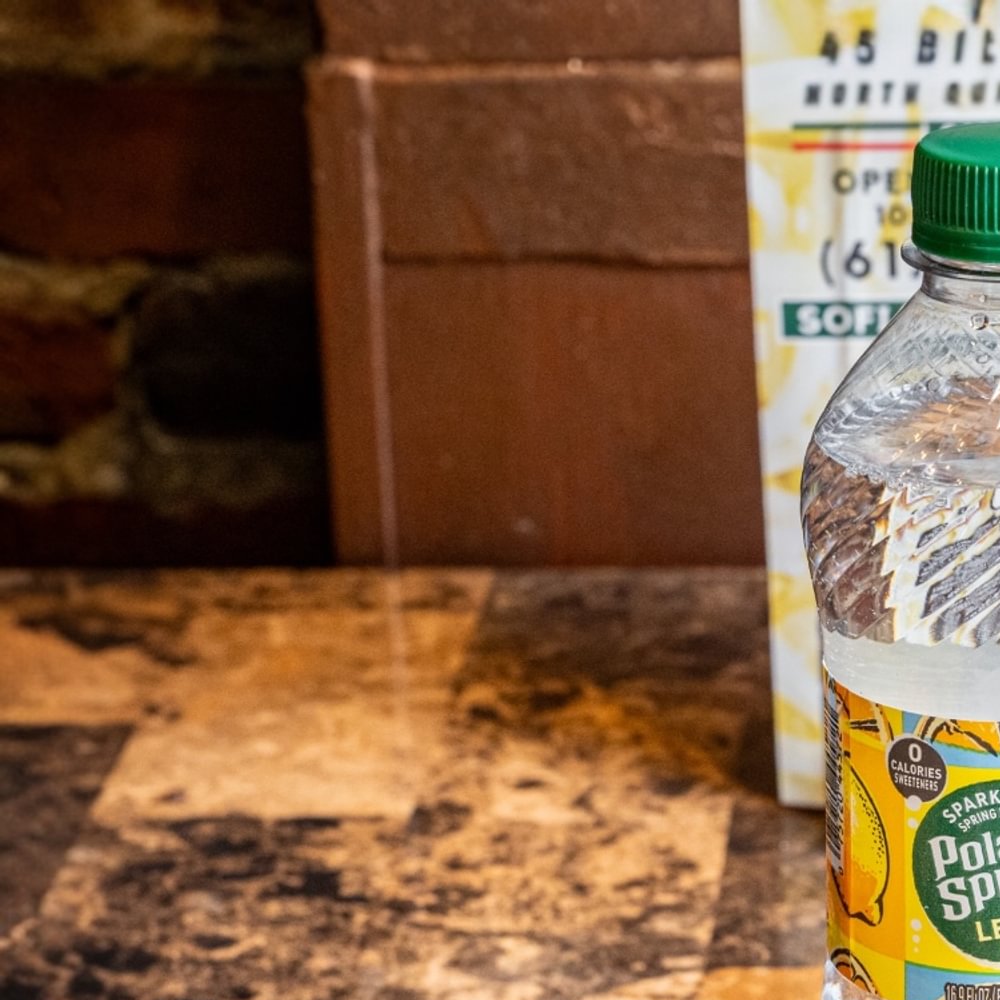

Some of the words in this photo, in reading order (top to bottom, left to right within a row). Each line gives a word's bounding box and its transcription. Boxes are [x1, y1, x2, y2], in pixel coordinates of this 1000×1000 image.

[820, 28, 876, 64] 45
[804, 82, 920, 105] NORTH
[833, 169, 911, 194] OPE
[821, 237, 919, 286] (61
[908, 743, 922, 763] 0
[890, 759, 943, 780] CALORIES
[894, 772, 940, 792] SWEETENERS
[958, 808, 998, 833] SPRING
